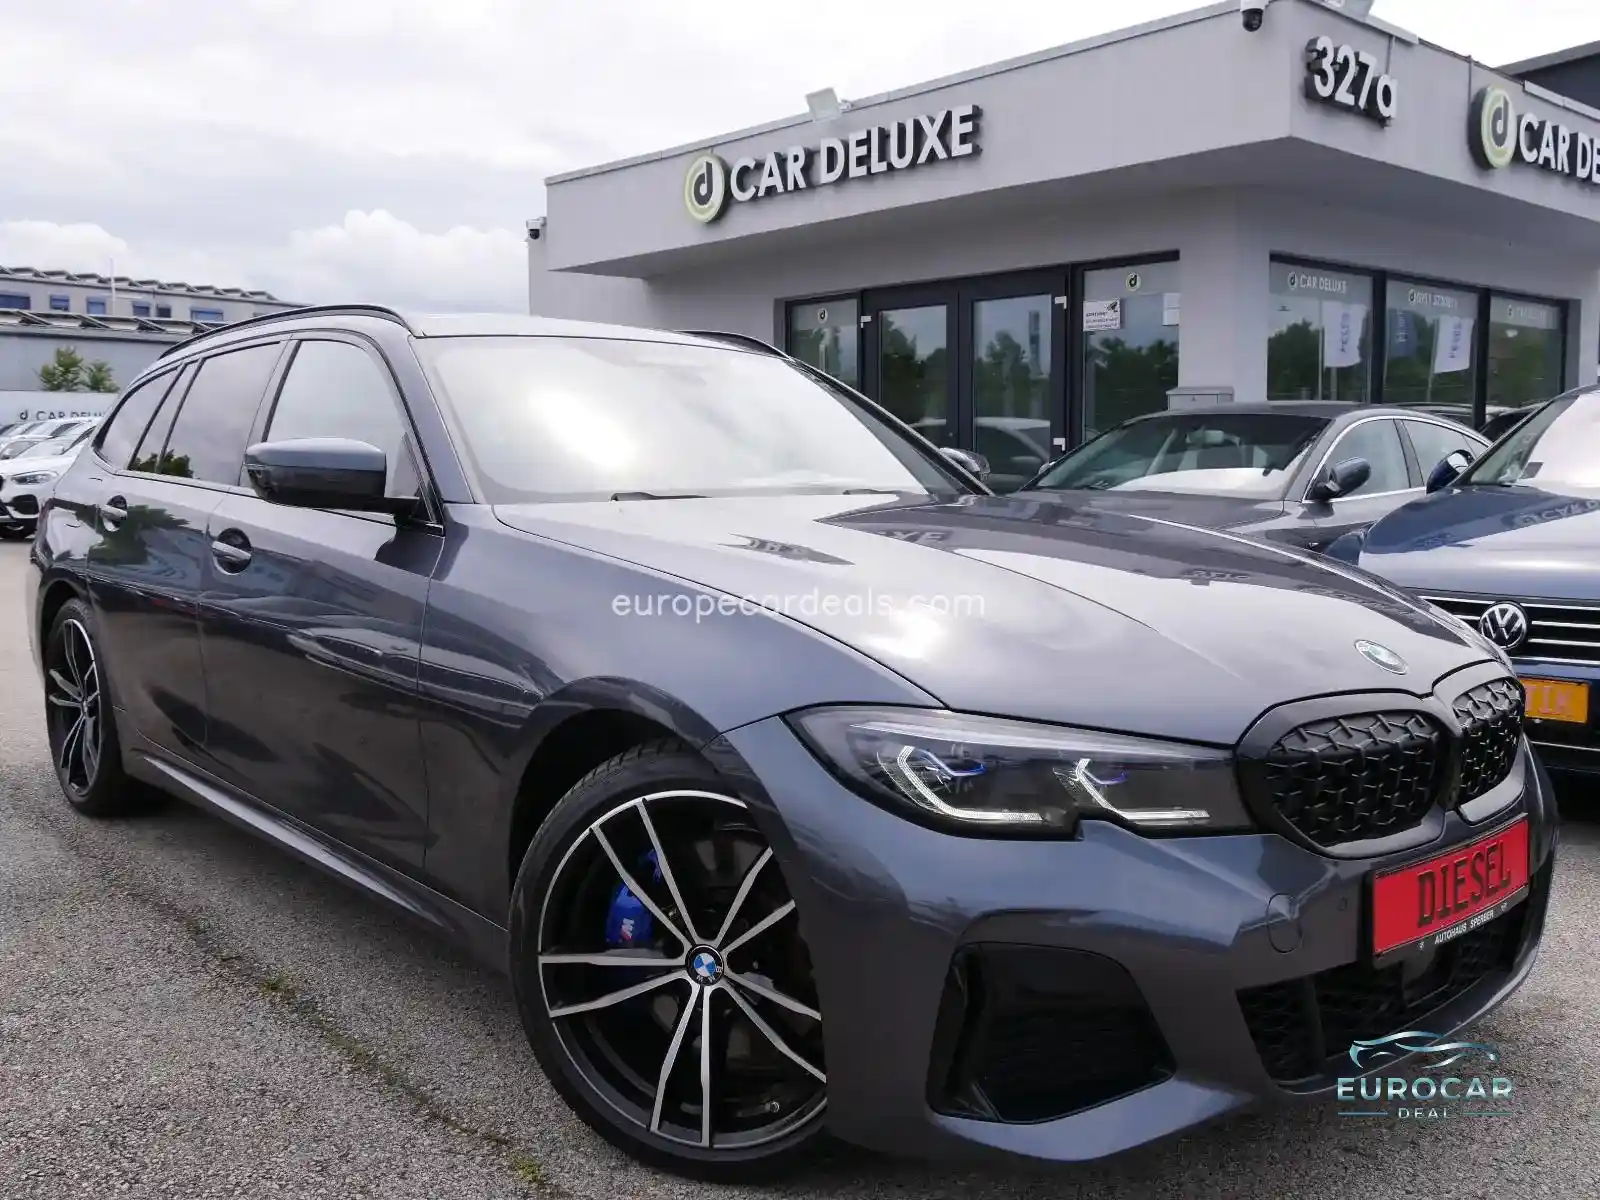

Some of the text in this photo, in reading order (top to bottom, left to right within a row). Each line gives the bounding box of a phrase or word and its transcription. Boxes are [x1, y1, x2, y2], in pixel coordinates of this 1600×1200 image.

[1312, 36, 1398, 119] 327a
[730, 145, 808, 202] CAR
[819, 104, 977, 184] DELUXE
[1519, 112, 1571, 174] CAR
[1416, 839, 1511, 928] DIESEL
[1434, 922, 1468, 945] AUTOHAUS
